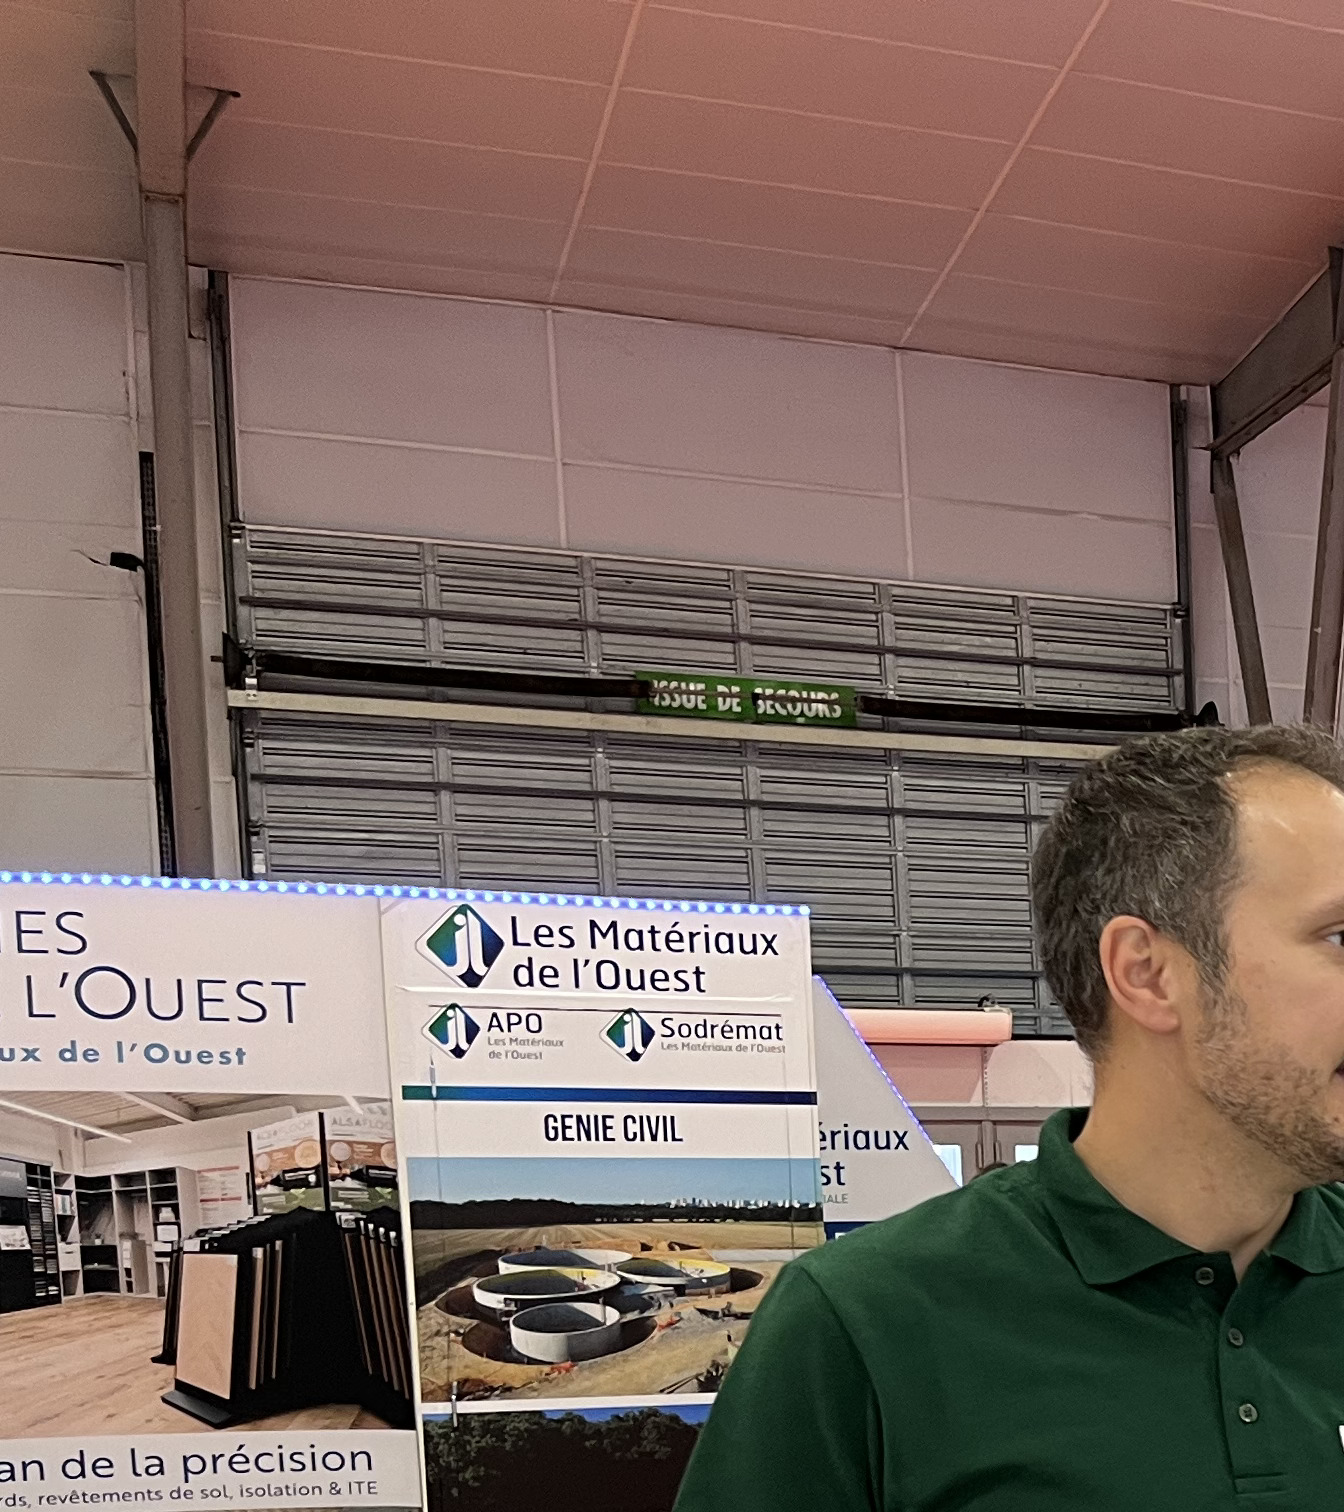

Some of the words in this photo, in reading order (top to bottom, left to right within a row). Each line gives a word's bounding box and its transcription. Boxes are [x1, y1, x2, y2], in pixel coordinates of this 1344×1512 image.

[652, 680, 707, 710] ISSUE
[716, 685, 742, 713] DE
[754, 687, 842, 718] SECOURS
[510, 916, 575, 949] Les
[590, 919, 780, 956] Matériaux
[513, 957, 559, 988] de
[573, 959, 706, 993] l'Ouest
[487, 1012, 543, 1034] APO
[660, 1017, 784, 1042] Sodrémat
[58, 1040, 100, 1063] de
[117, 1041, 247, 1066] l'Ouest
[487, 1037, 507, 1047] Les
[509, 1037, 564, 1048] Matériaux
[488, 1050, 503, 1060] de
[505, 1049, 544, 1060] l'Ouest
[661, 1042, 678, 1052] Les
[679, 1042, 733, 1053] Matériaux
[735, 1043, 748, 1053] de
[544, 1114, 616, 1142] GENIE
[623, 1115, 684, 1142] CIVIL
[61, 1449, 115, 1480] de
[130, 1447, 165, 1478] la
[182, 1443, 374, 1483] précision
[38, 1486, 163, 1507] revêtements
[170, 1485, 194, 1501] de
[200, 1484, 234, 1502] sol,
[239, 1481, 322, 1498] isolation
[328, 1481, 342, 1496] &
[347, 1480, 379, 1496] ITE
